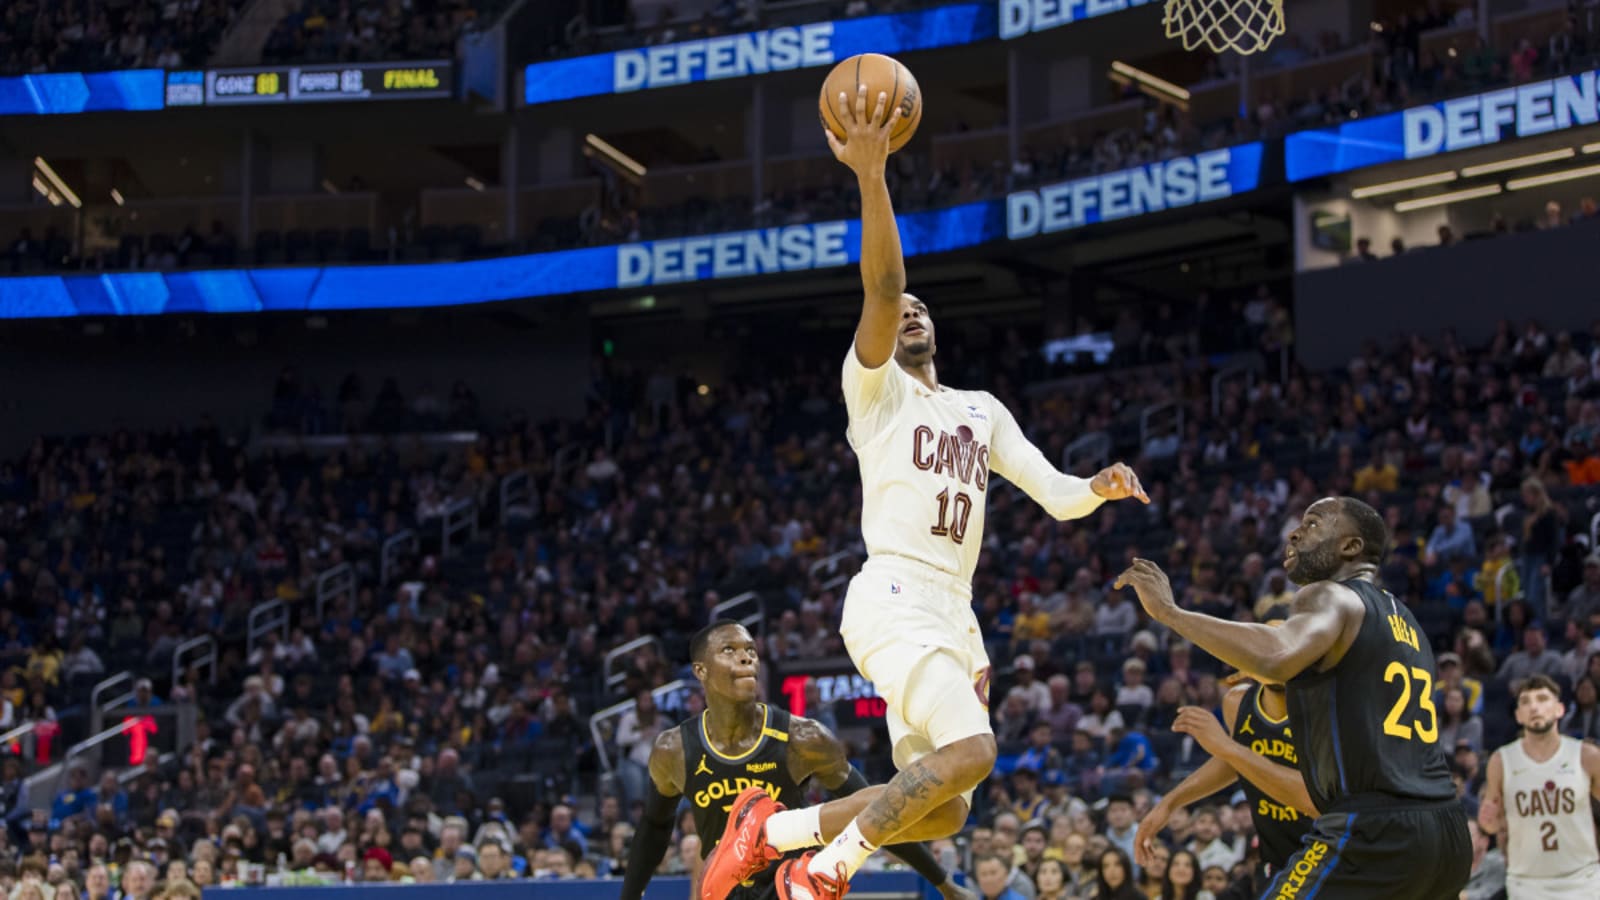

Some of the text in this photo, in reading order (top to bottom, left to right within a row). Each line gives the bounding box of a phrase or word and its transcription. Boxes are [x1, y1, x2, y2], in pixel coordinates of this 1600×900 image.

[383, 68, 439, 89] FINAL
[613, 22, 835, 93] DEFENSE
[1403, 70, 1600, 160] DEFEN
[1006, 147, 1233, 240] DEFENSE
[616, 220, 848, 289] DEFENSE
[912, 424, 989, 492] CAVS
[930, 486, 972, 545] 10
[1383, 661, 1438, 744] 23
[1514, 787, 1576, 817] CAVS
[1538, 821, 1560, 852] 2
